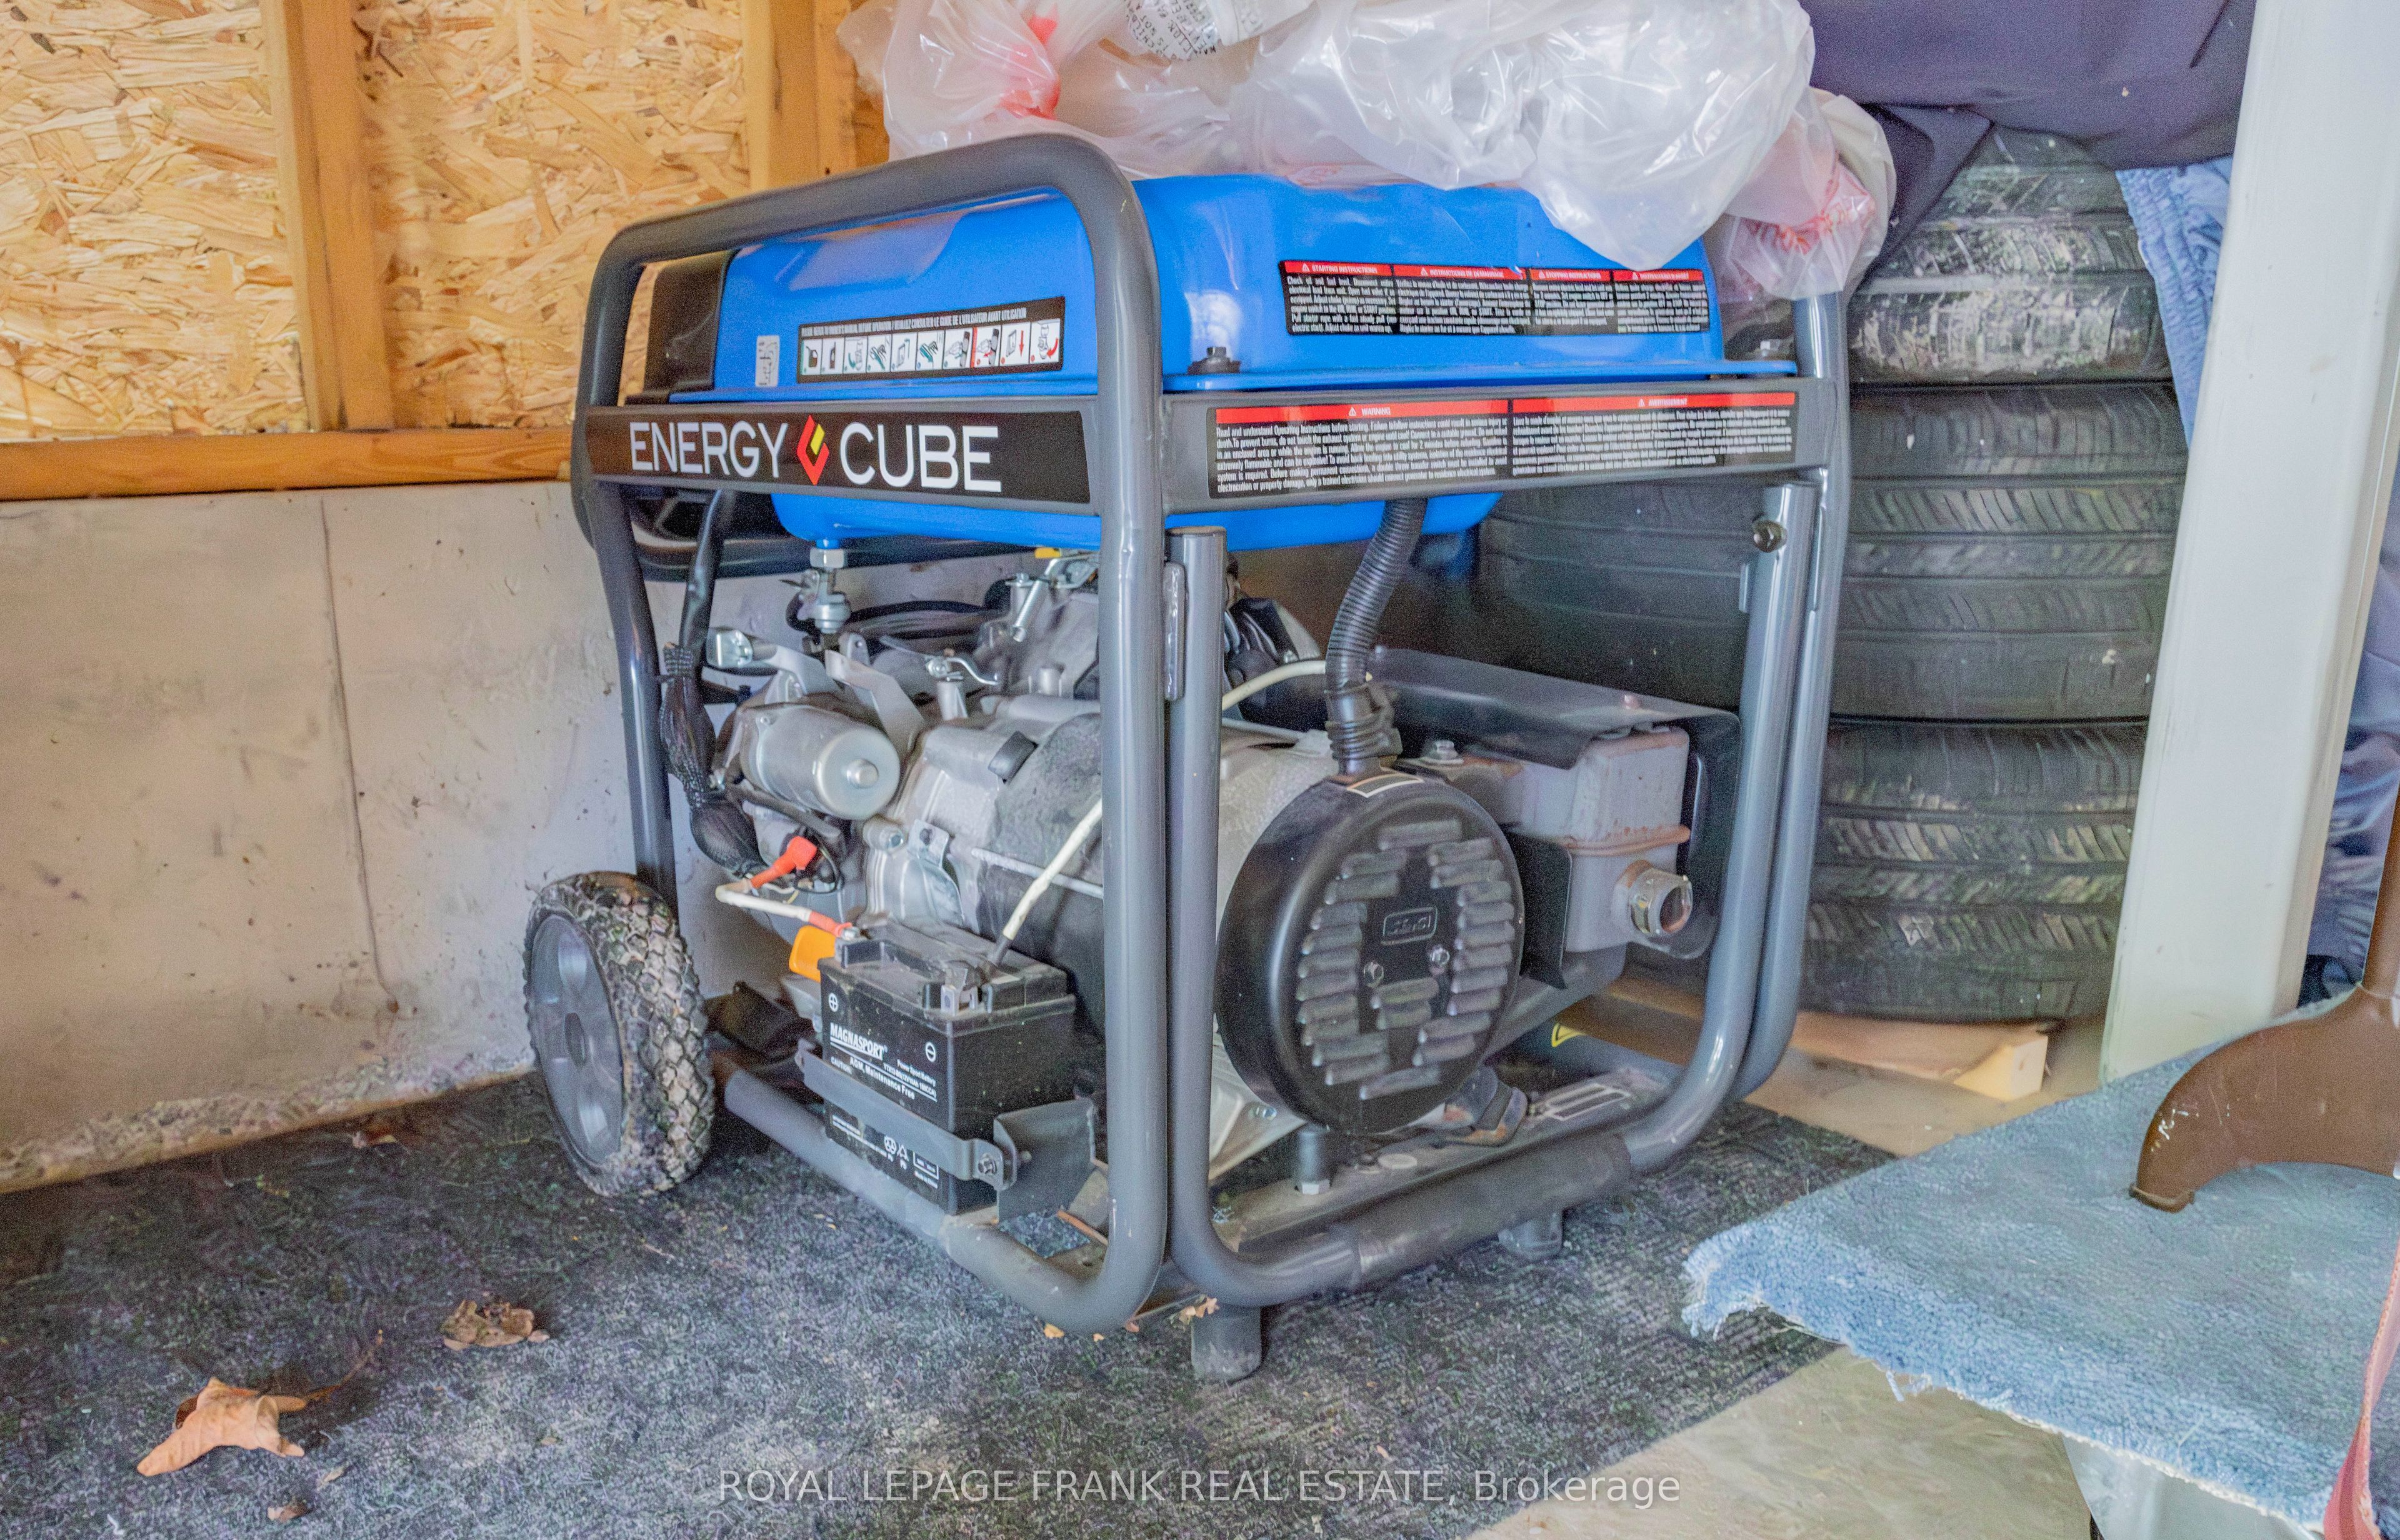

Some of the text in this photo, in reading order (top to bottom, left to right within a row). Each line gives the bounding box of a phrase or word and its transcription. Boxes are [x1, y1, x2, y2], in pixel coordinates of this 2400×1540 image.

[1339, 265, 1378, 274] INSTRUCTIONS
[1361, 407, 1391, 416] WARNING
[1216, 426, 1229, 437] Read
[1274, 424, 1299, 436] Operating
[630, 421, 1001, 492] ENERGY CUBE
[830, 1022, 885, 1060] MAGNASPORT
[865, 1064, 901, 1092] Maintenance
[901, 1084, 915, 1100] Free
